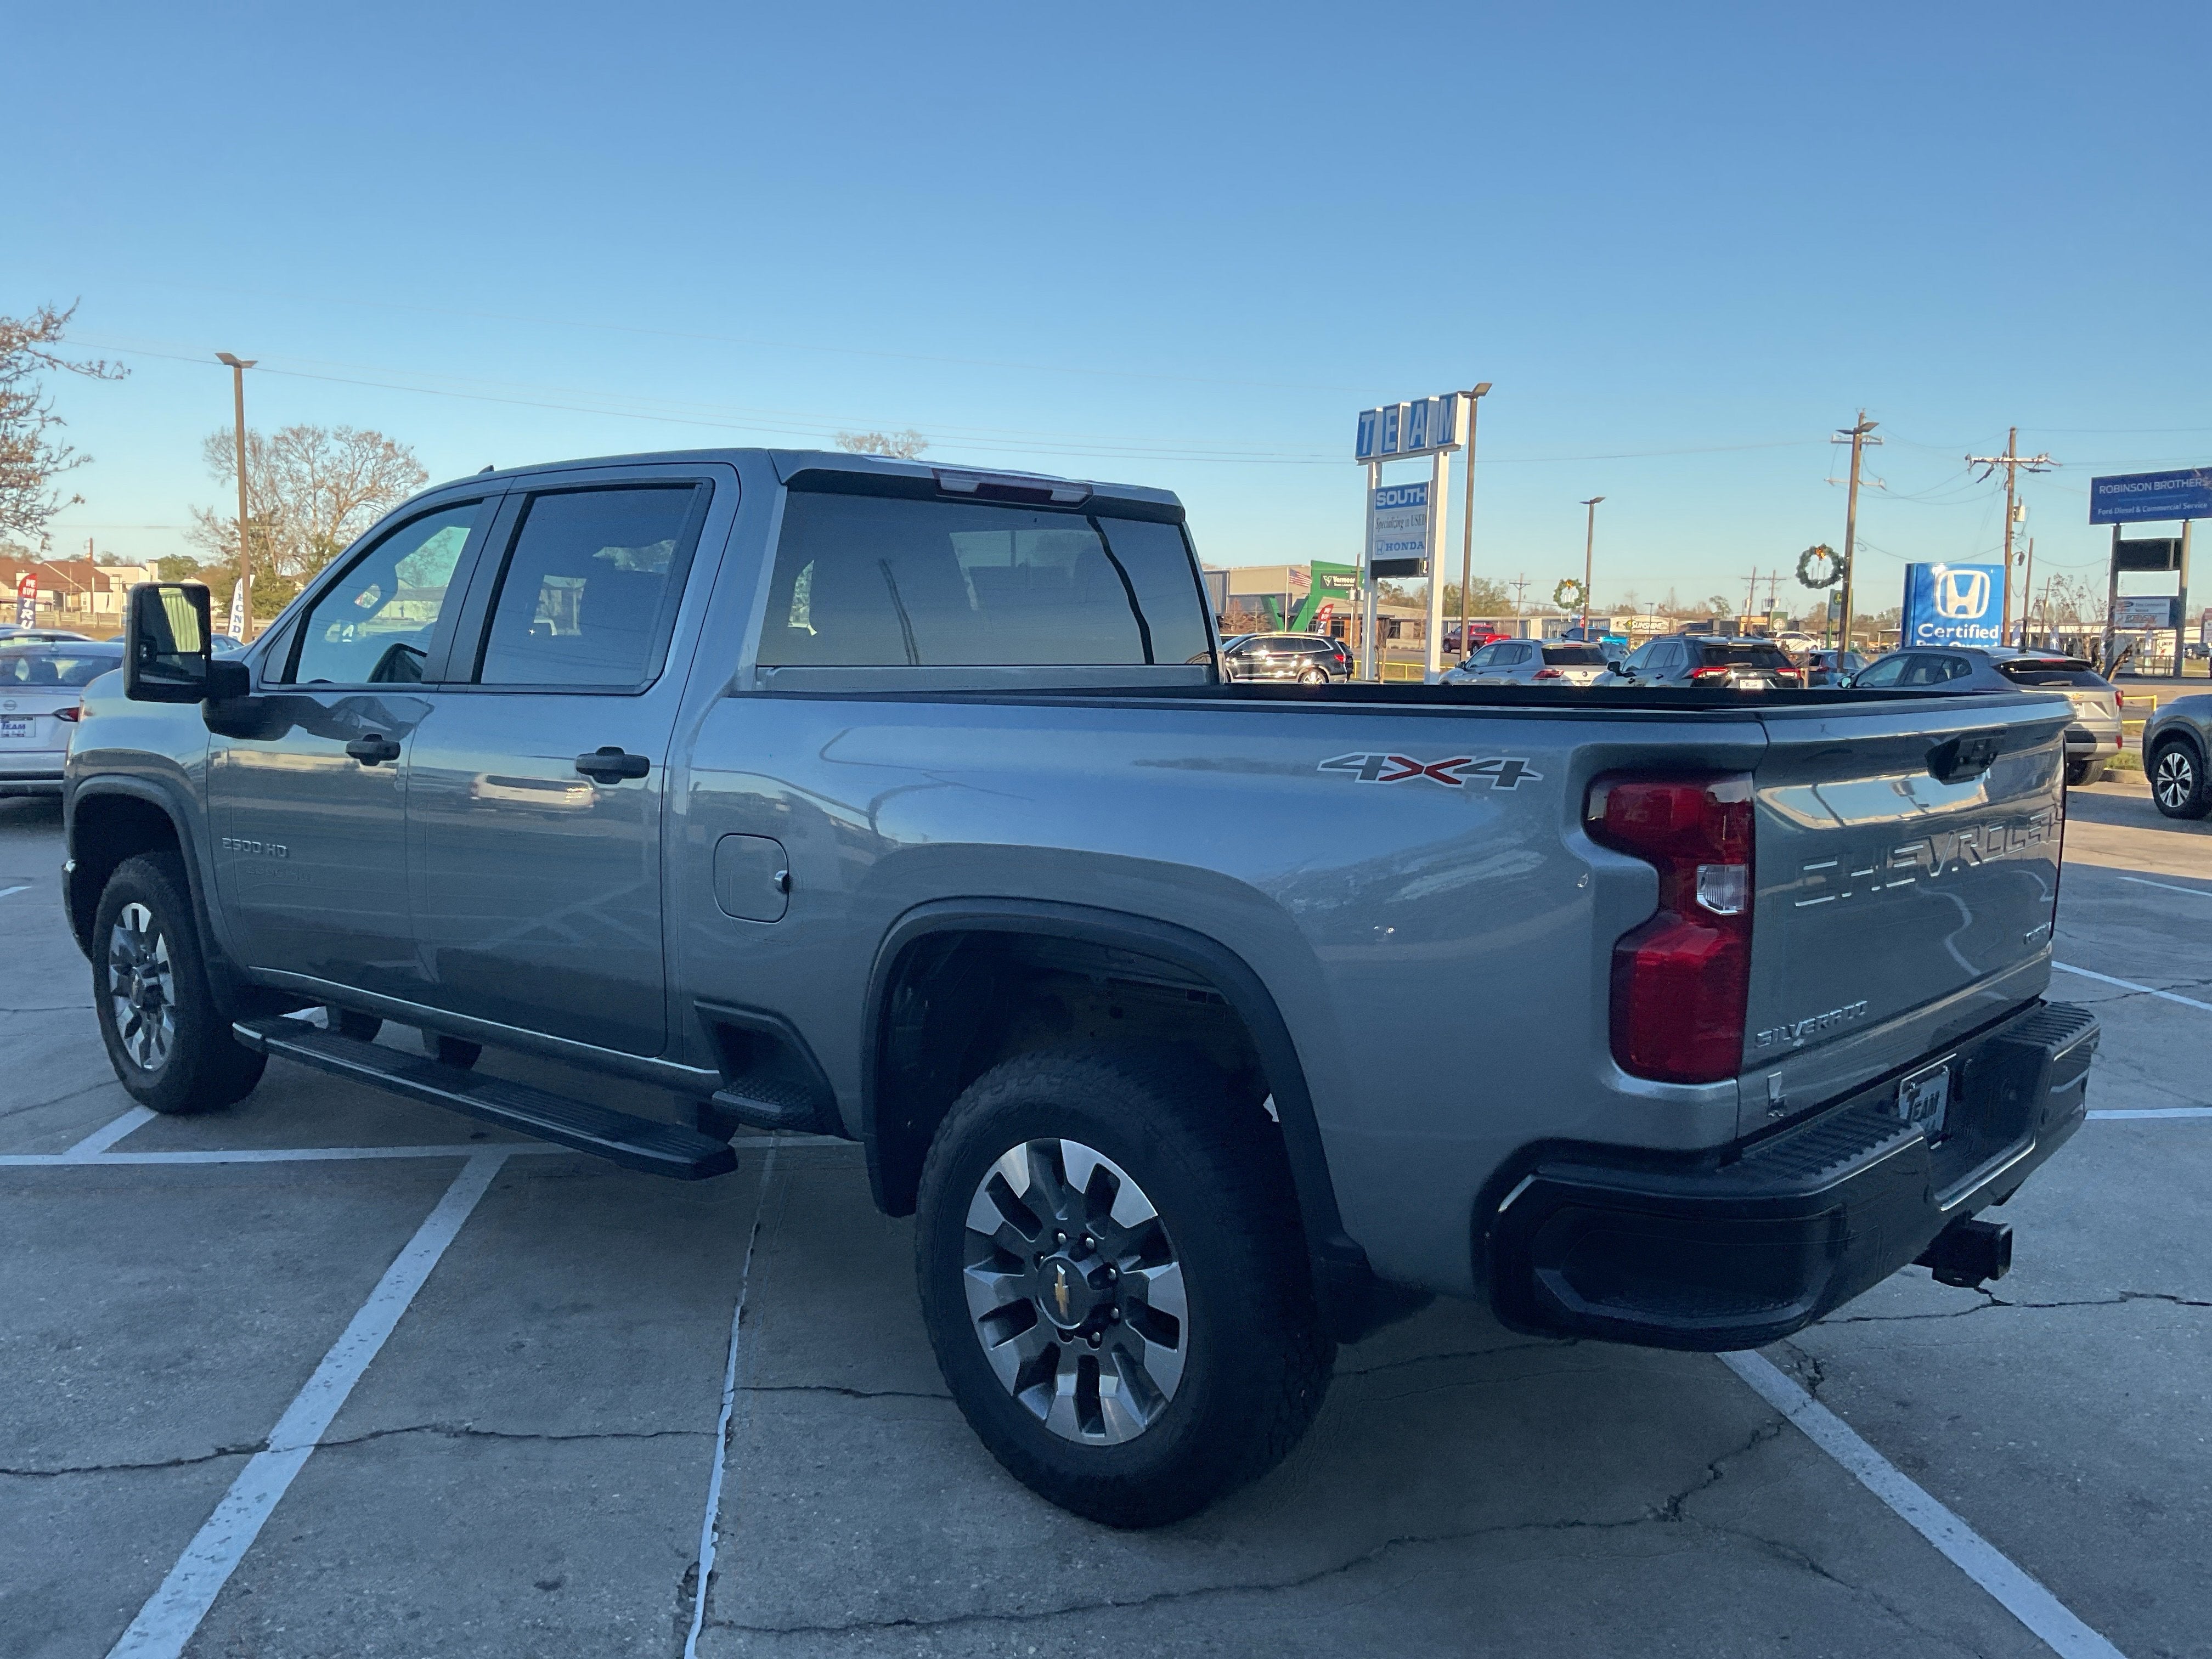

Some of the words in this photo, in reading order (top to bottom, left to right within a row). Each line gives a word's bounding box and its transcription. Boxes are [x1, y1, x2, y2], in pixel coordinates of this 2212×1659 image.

[1361, 396, 1457, 455] TEAM
[1376, 486, 1426, 506] SOUTH
[2099, 482, 2152, 494] ROBINSON
[2114, 506, 2134, 514] Diesel
[2142, 503, 2181, 512] Commercial
[1375, 516, 1404, 532] Specializing
[1405, 517, 1410, 527] in
[1411, 514, 1426, 527] USED
[1385, 541, 1424, 551] HONDA
[1917, 623, 1999, 639] Certified
